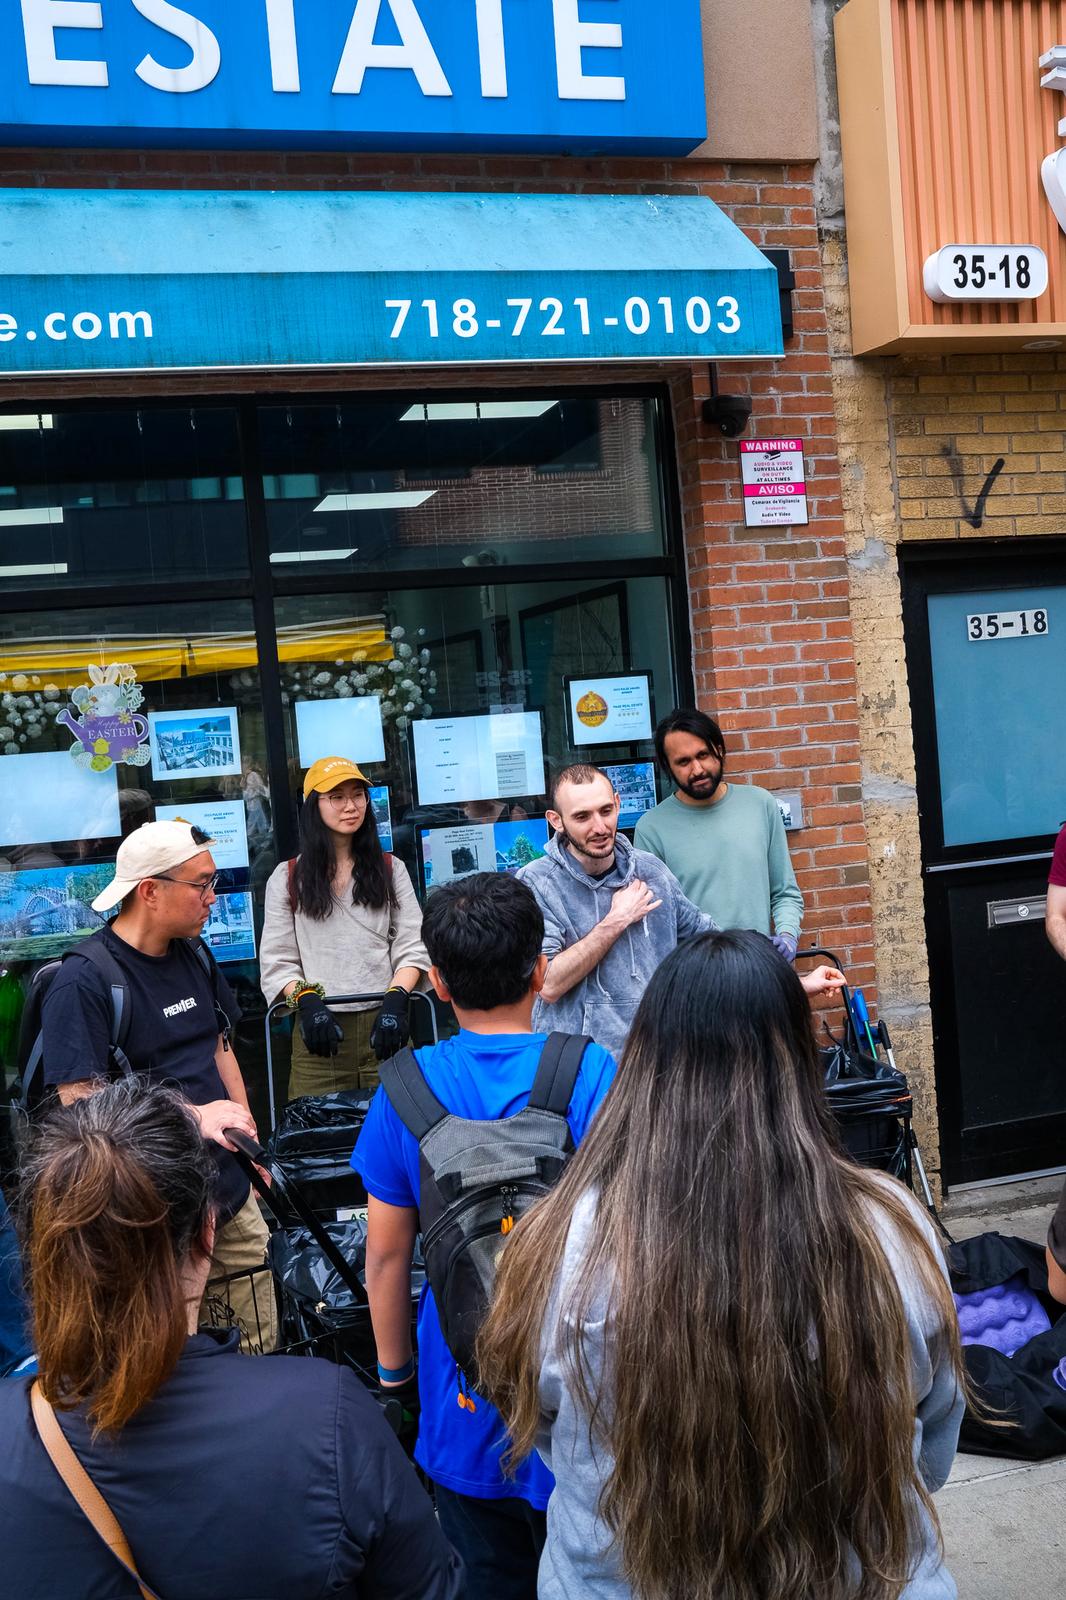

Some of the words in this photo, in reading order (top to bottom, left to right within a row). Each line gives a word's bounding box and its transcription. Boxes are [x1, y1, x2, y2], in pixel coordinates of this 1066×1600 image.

[953, 254, 1031, 289] 35-18
[385, 296, 741, 338] 718-721-0103
[745, 441, 797, 451] WARNING
[758, 485, 795, 494] AVISO
[970, 611, 1047, 639] 35-18
[88, 728, 134, 740] EASTER
[163, 997, 197, 1018] PREMIER
[351, 1212, 368, 1222] AS
